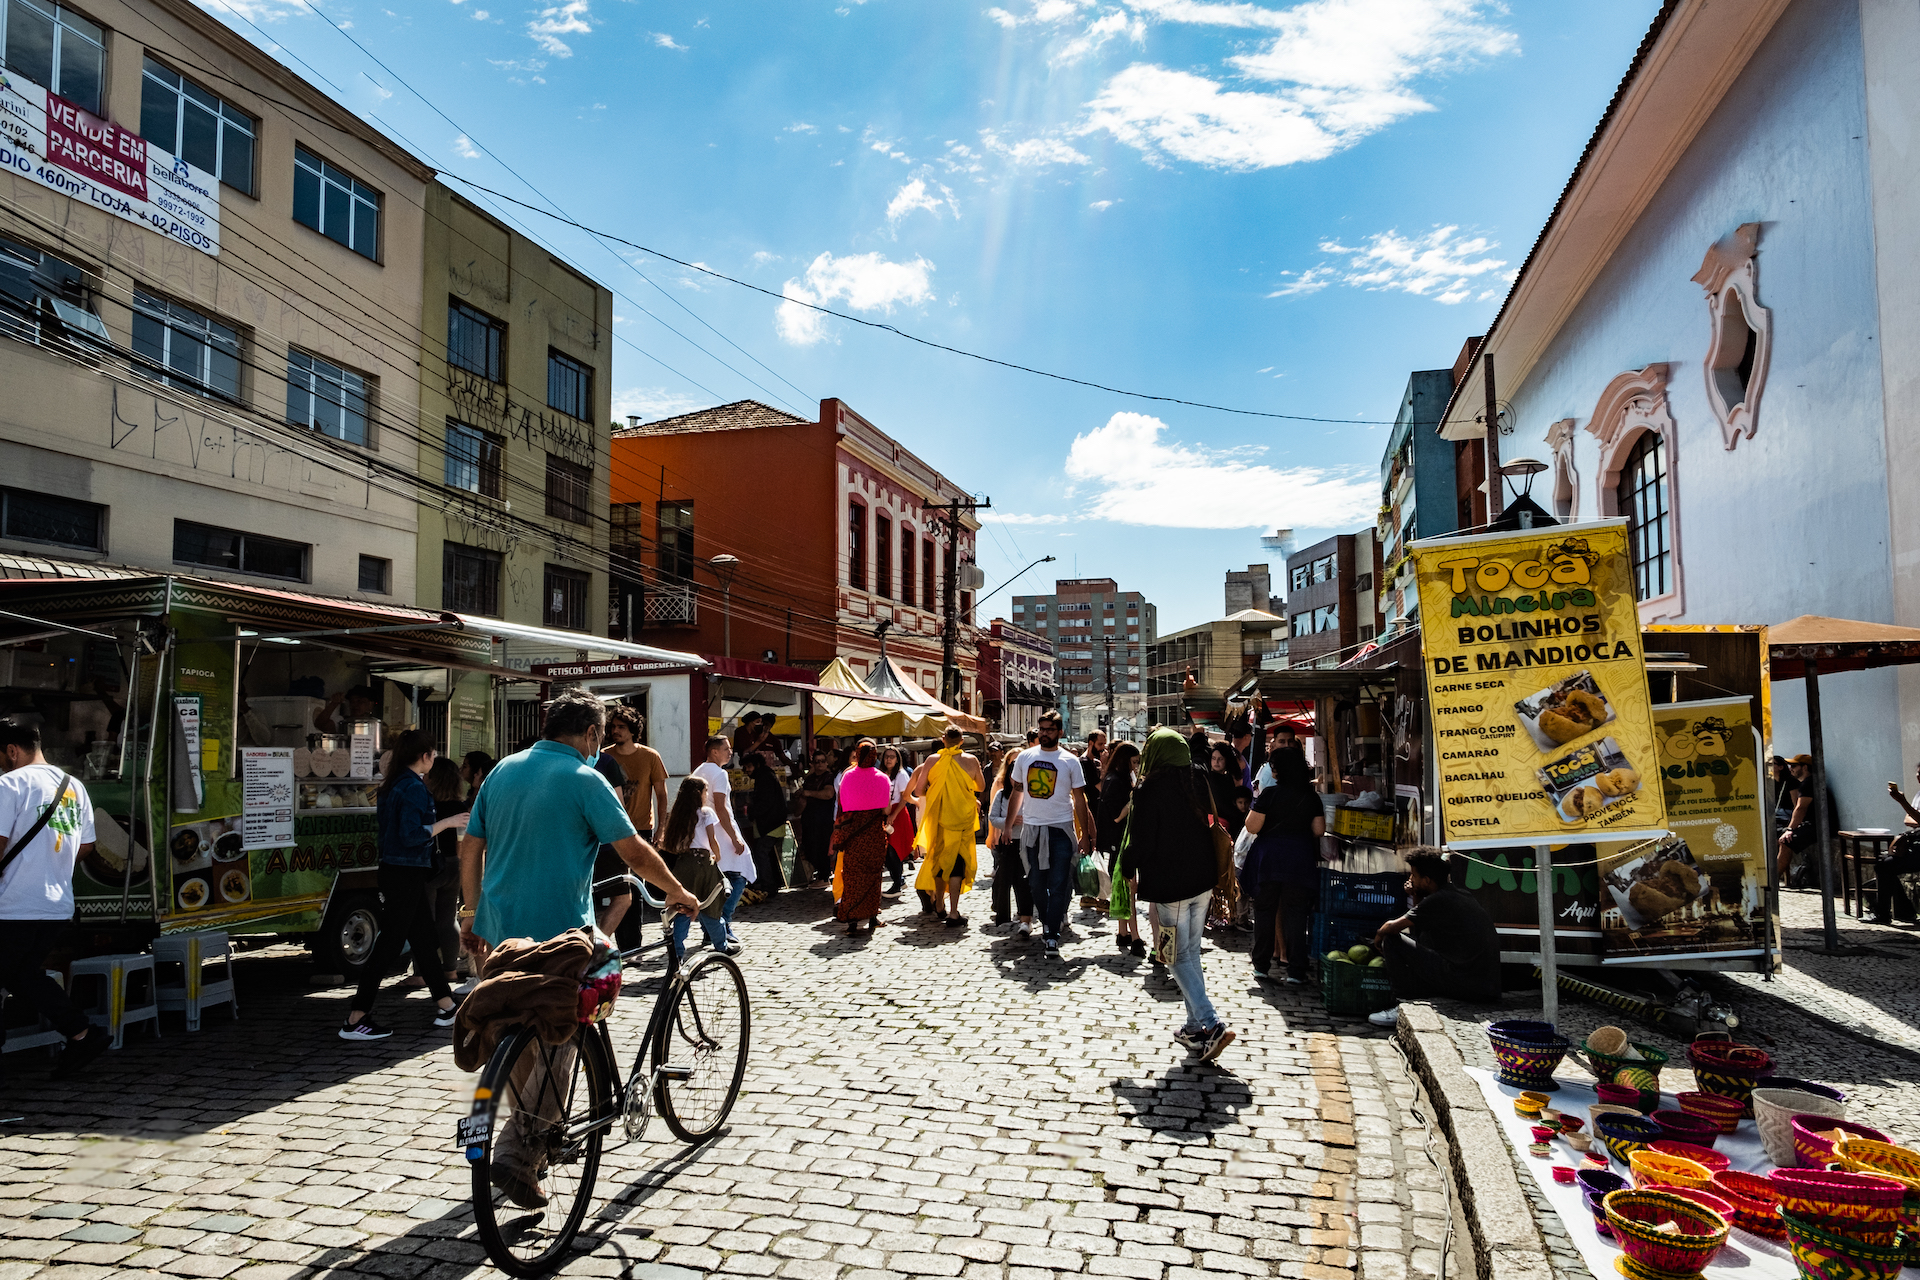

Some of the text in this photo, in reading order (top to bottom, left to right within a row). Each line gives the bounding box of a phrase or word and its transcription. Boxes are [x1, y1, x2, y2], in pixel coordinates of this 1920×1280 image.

[119, 133, 144, 163] EM
[51, 130, 145, 192] PARCERIA
[91, 188, 131, 216] LOJA
[152, 214, 167, 229] 02
[170, 222, 211, 249] PISOS
[158, 197, 206, 226] 99972-1992
[1458, 614, 1600, 644] BOLINHOS
[1434, 640, 1634, 675] DE MANDIOCA
[180, 667, 215, 678] TAPIOCA
[547, 666, 583, 676] PETISCOS
[1434, 680, 1505, 693] CARNE SECA
[1437, 704, 1483, 716] FRANGO
[1439, 724, 1516, 738] FRANGO COM
[1480, 731, 1516, 740] CATUPIRY
[1442, 747, 1499, 760] CAMARÃO
[1445, 771, 1505, 783] BACALHAU
[1447, 791, 1545, 806] QUATRO QUEIJOS
[1583, 803, 1613, 823] PROVE
[1597, 806, 1636, 828] TAMBÉM
[1449, 816, 1500, 828] COSTELA
[1703, 851, 1752, 861] Matraqueando
[1559, 900, 1598, 923] Aqui
[458, 1133, 489, 1146] ALEMANHA
